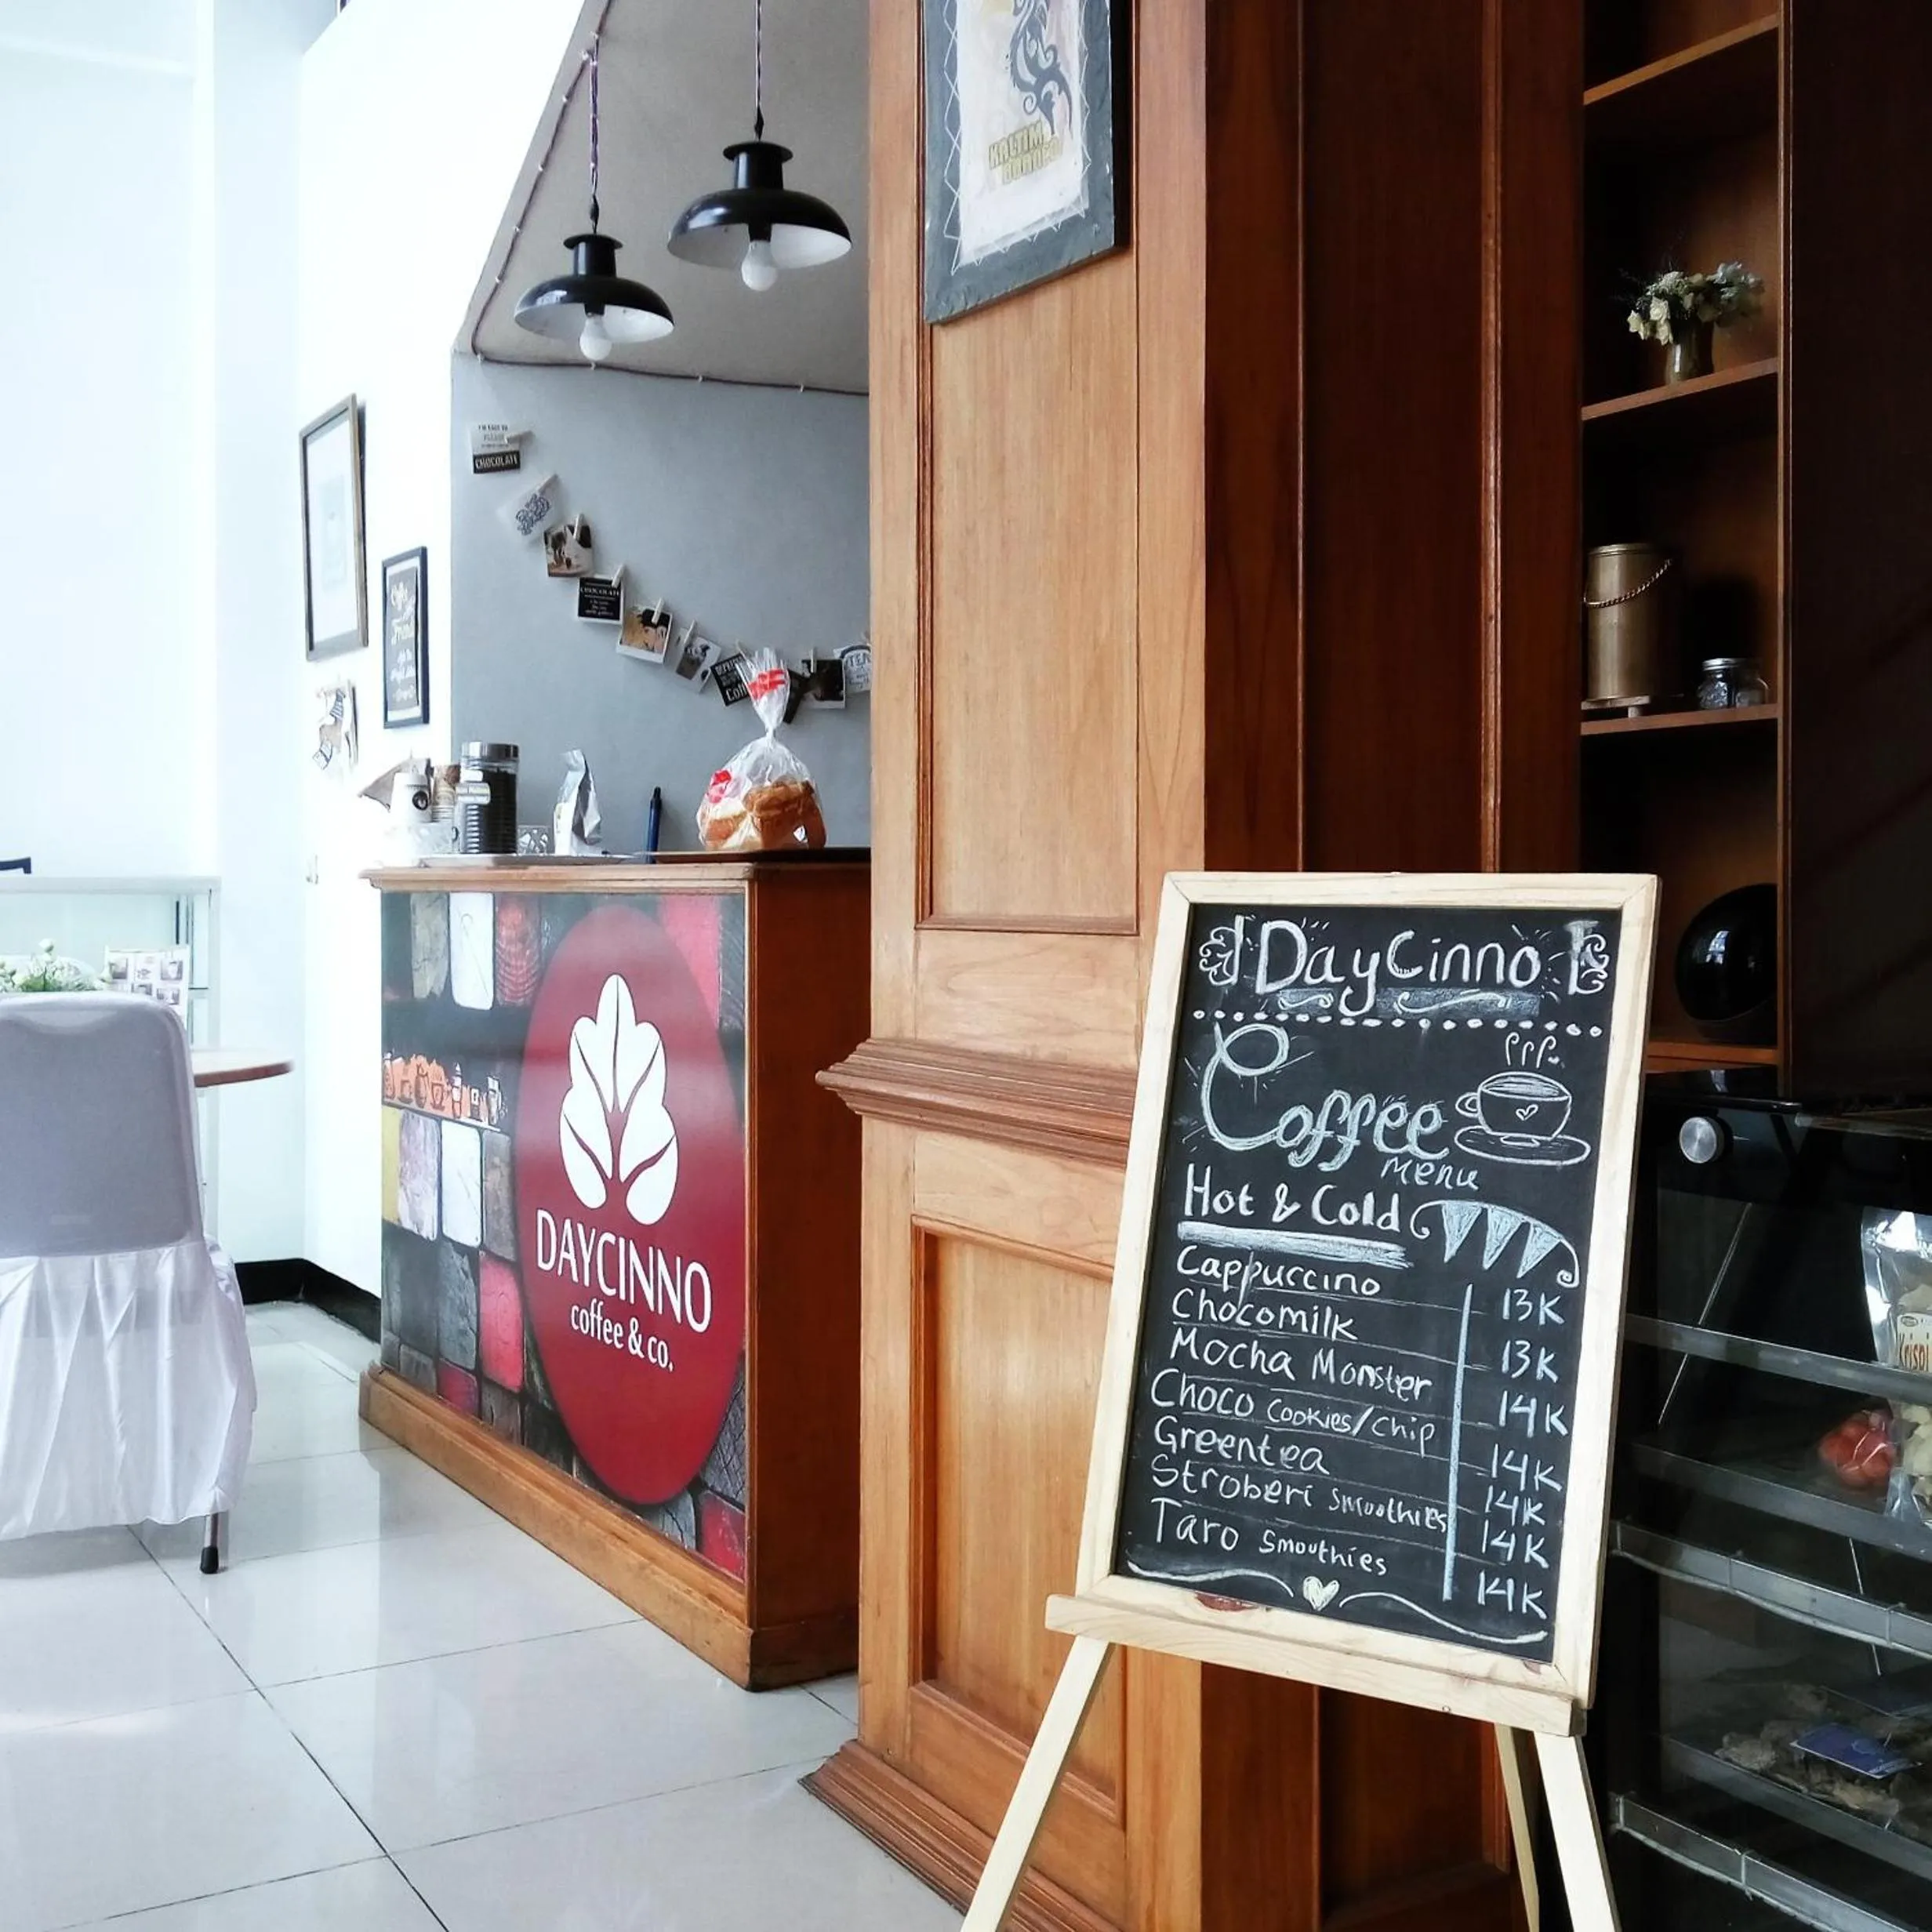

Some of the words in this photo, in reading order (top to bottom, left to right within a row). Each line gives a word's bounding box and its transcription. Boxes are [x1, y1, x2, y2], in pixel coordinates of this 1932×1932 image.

[1201, 1022, 1450, 1171] Coffee
[1184, 1163, 1255, 1216] Hot
[1271, 1182, 1302, 1222] &
[1311, 1184, 1401, 1233] Cold
[536, 1208, 712, 1333] DAYCINNO
[1177, 1245, 1381, 1308] Cappuccino
[571, 1298, 624, 1349] coffee
[627, 1316, 645, 1358] &
[1172, 1287, 1359, 1342] Chocomilk
[1170, 1327, 1295, 1381] Mocha
[1312, 1348, 1433, 1402] Monster
[1154, 1415, 1331, 1476] Greentea
[1151, 1453, 1313, 1507] Stroberi
[1150, 1497, 1239, 1551] Taro
